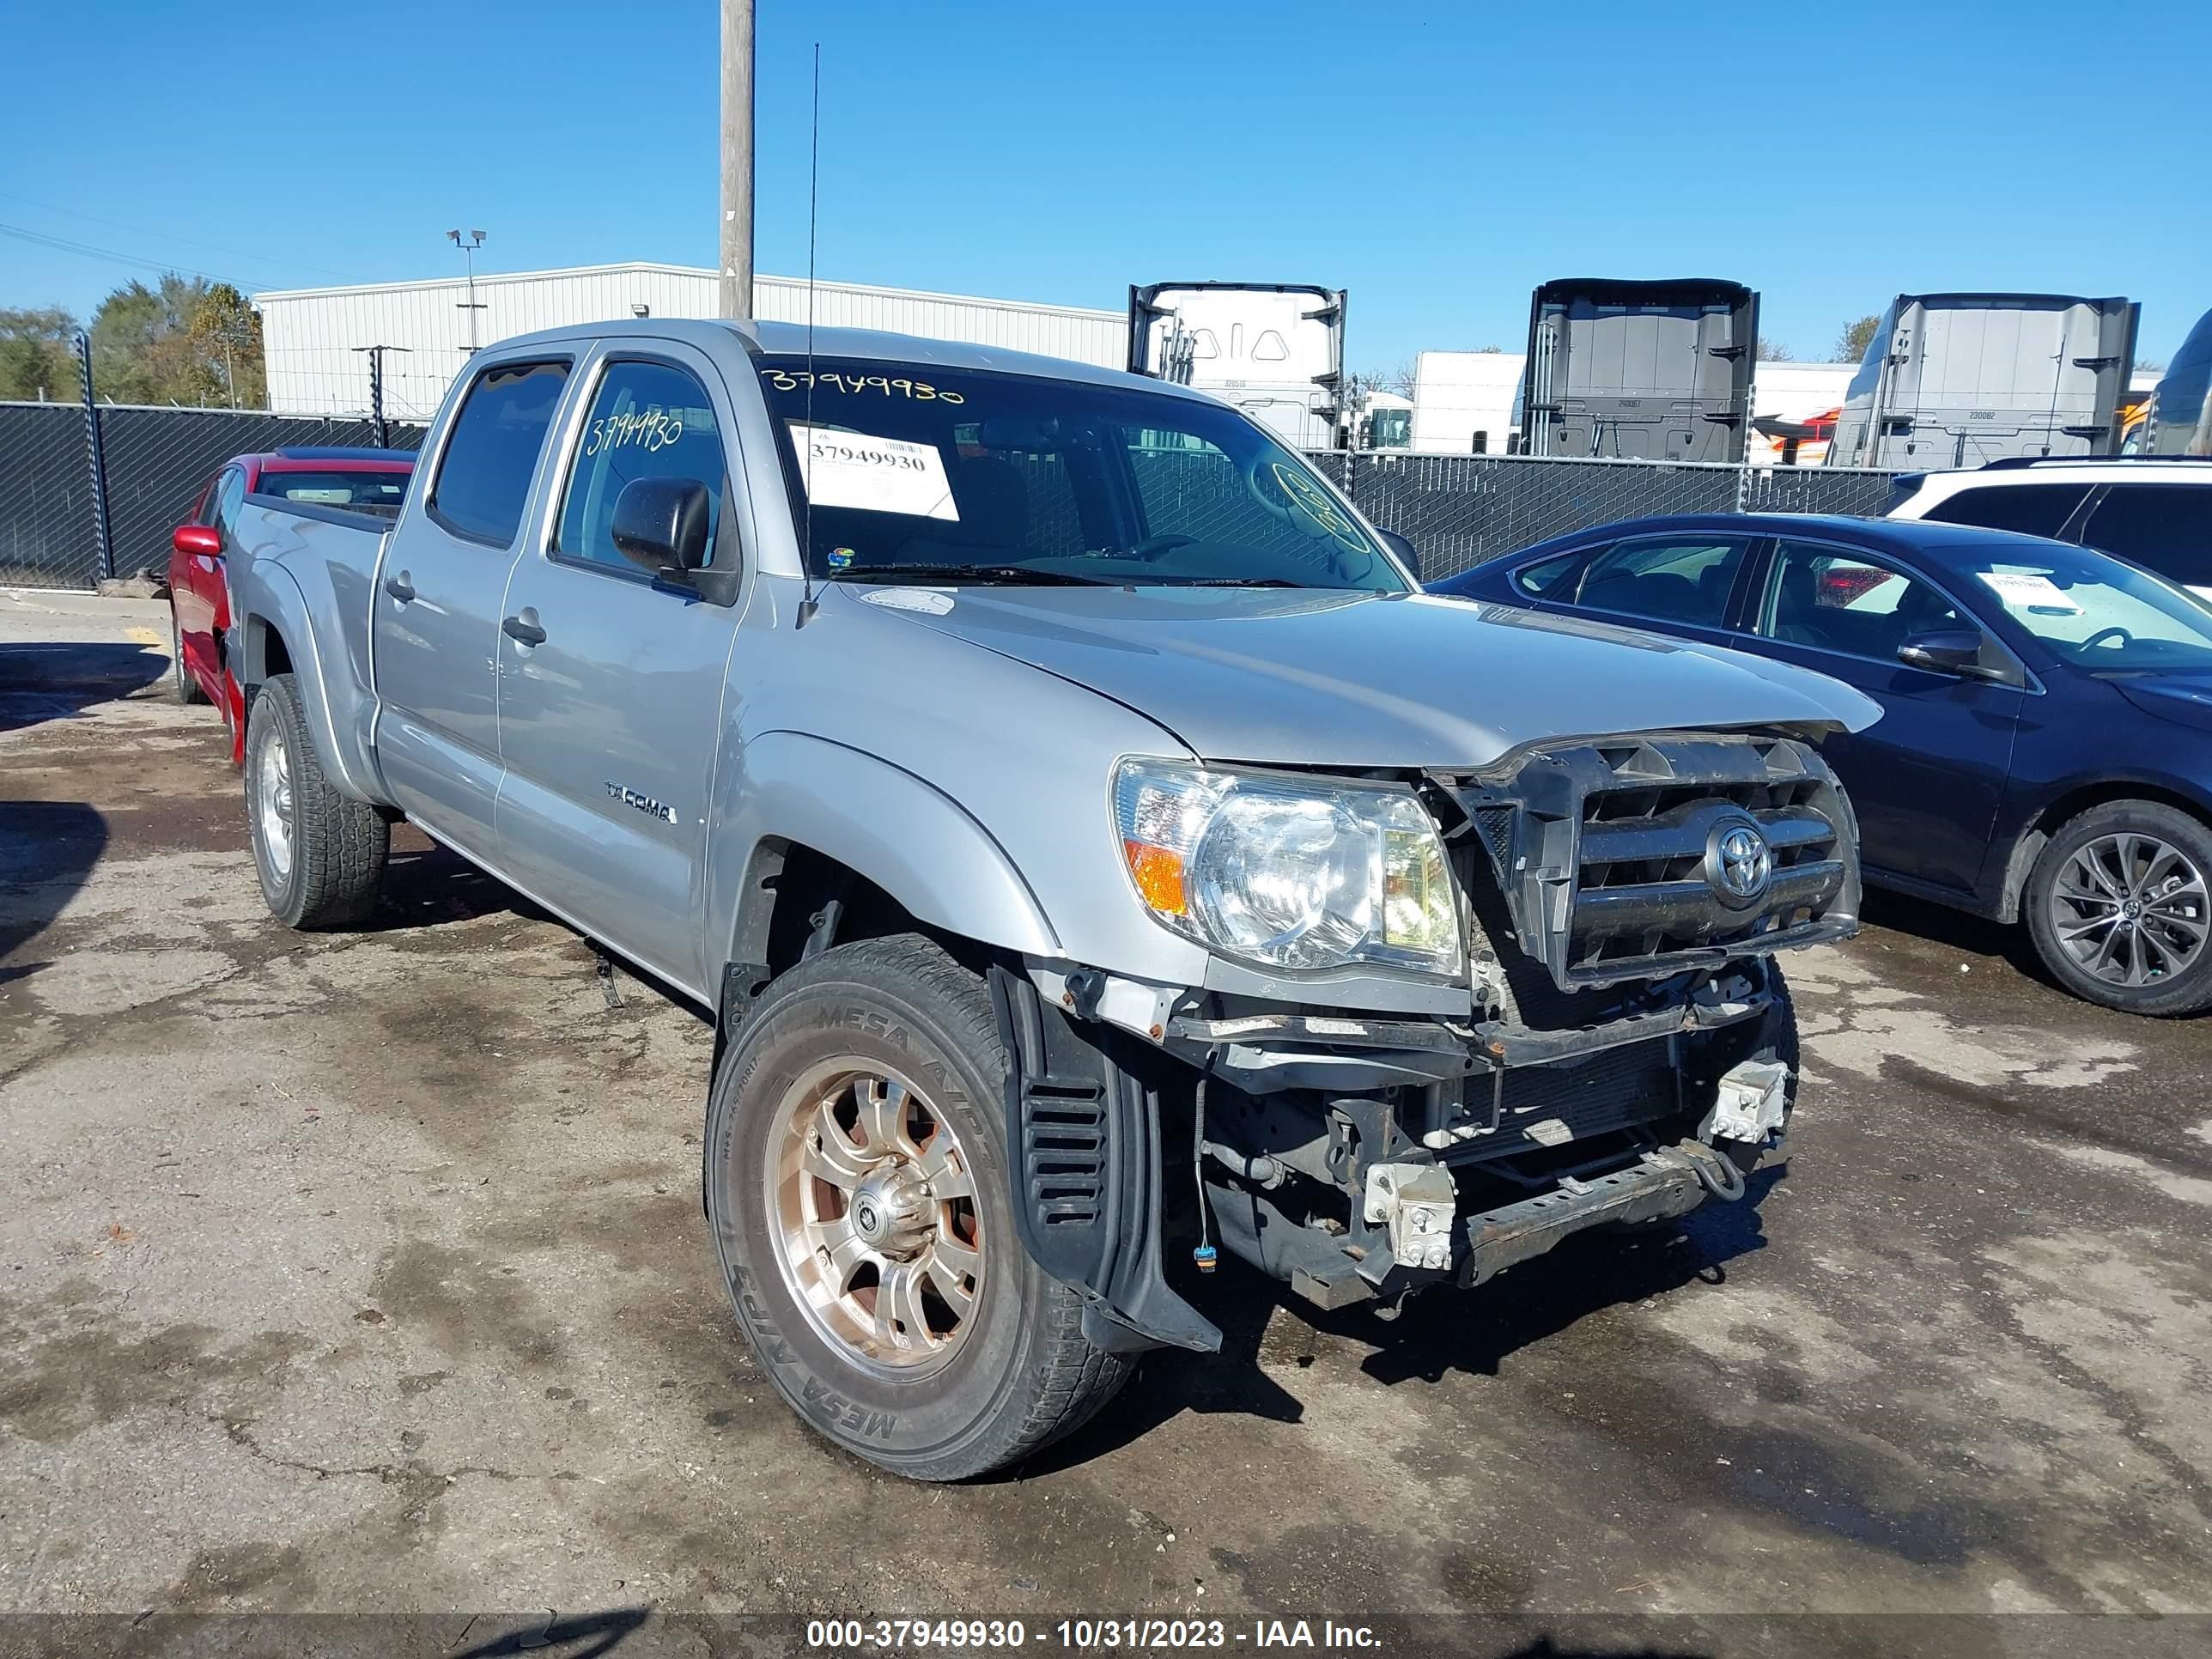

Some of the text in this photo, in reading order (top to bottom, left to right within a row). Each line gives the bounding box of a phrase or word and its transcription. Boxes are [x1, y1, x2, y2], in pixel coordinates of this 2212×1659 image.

[761, 369, 964, 404] 37949930
[587, 410, 682, 456] 37949930
[811, 444, 926, 472] 37949930
[605, 780, 678, 824] TACOMA
[817, 1006, 911, 1053] MESA
[802, 1376, 896, 1439] MESA
